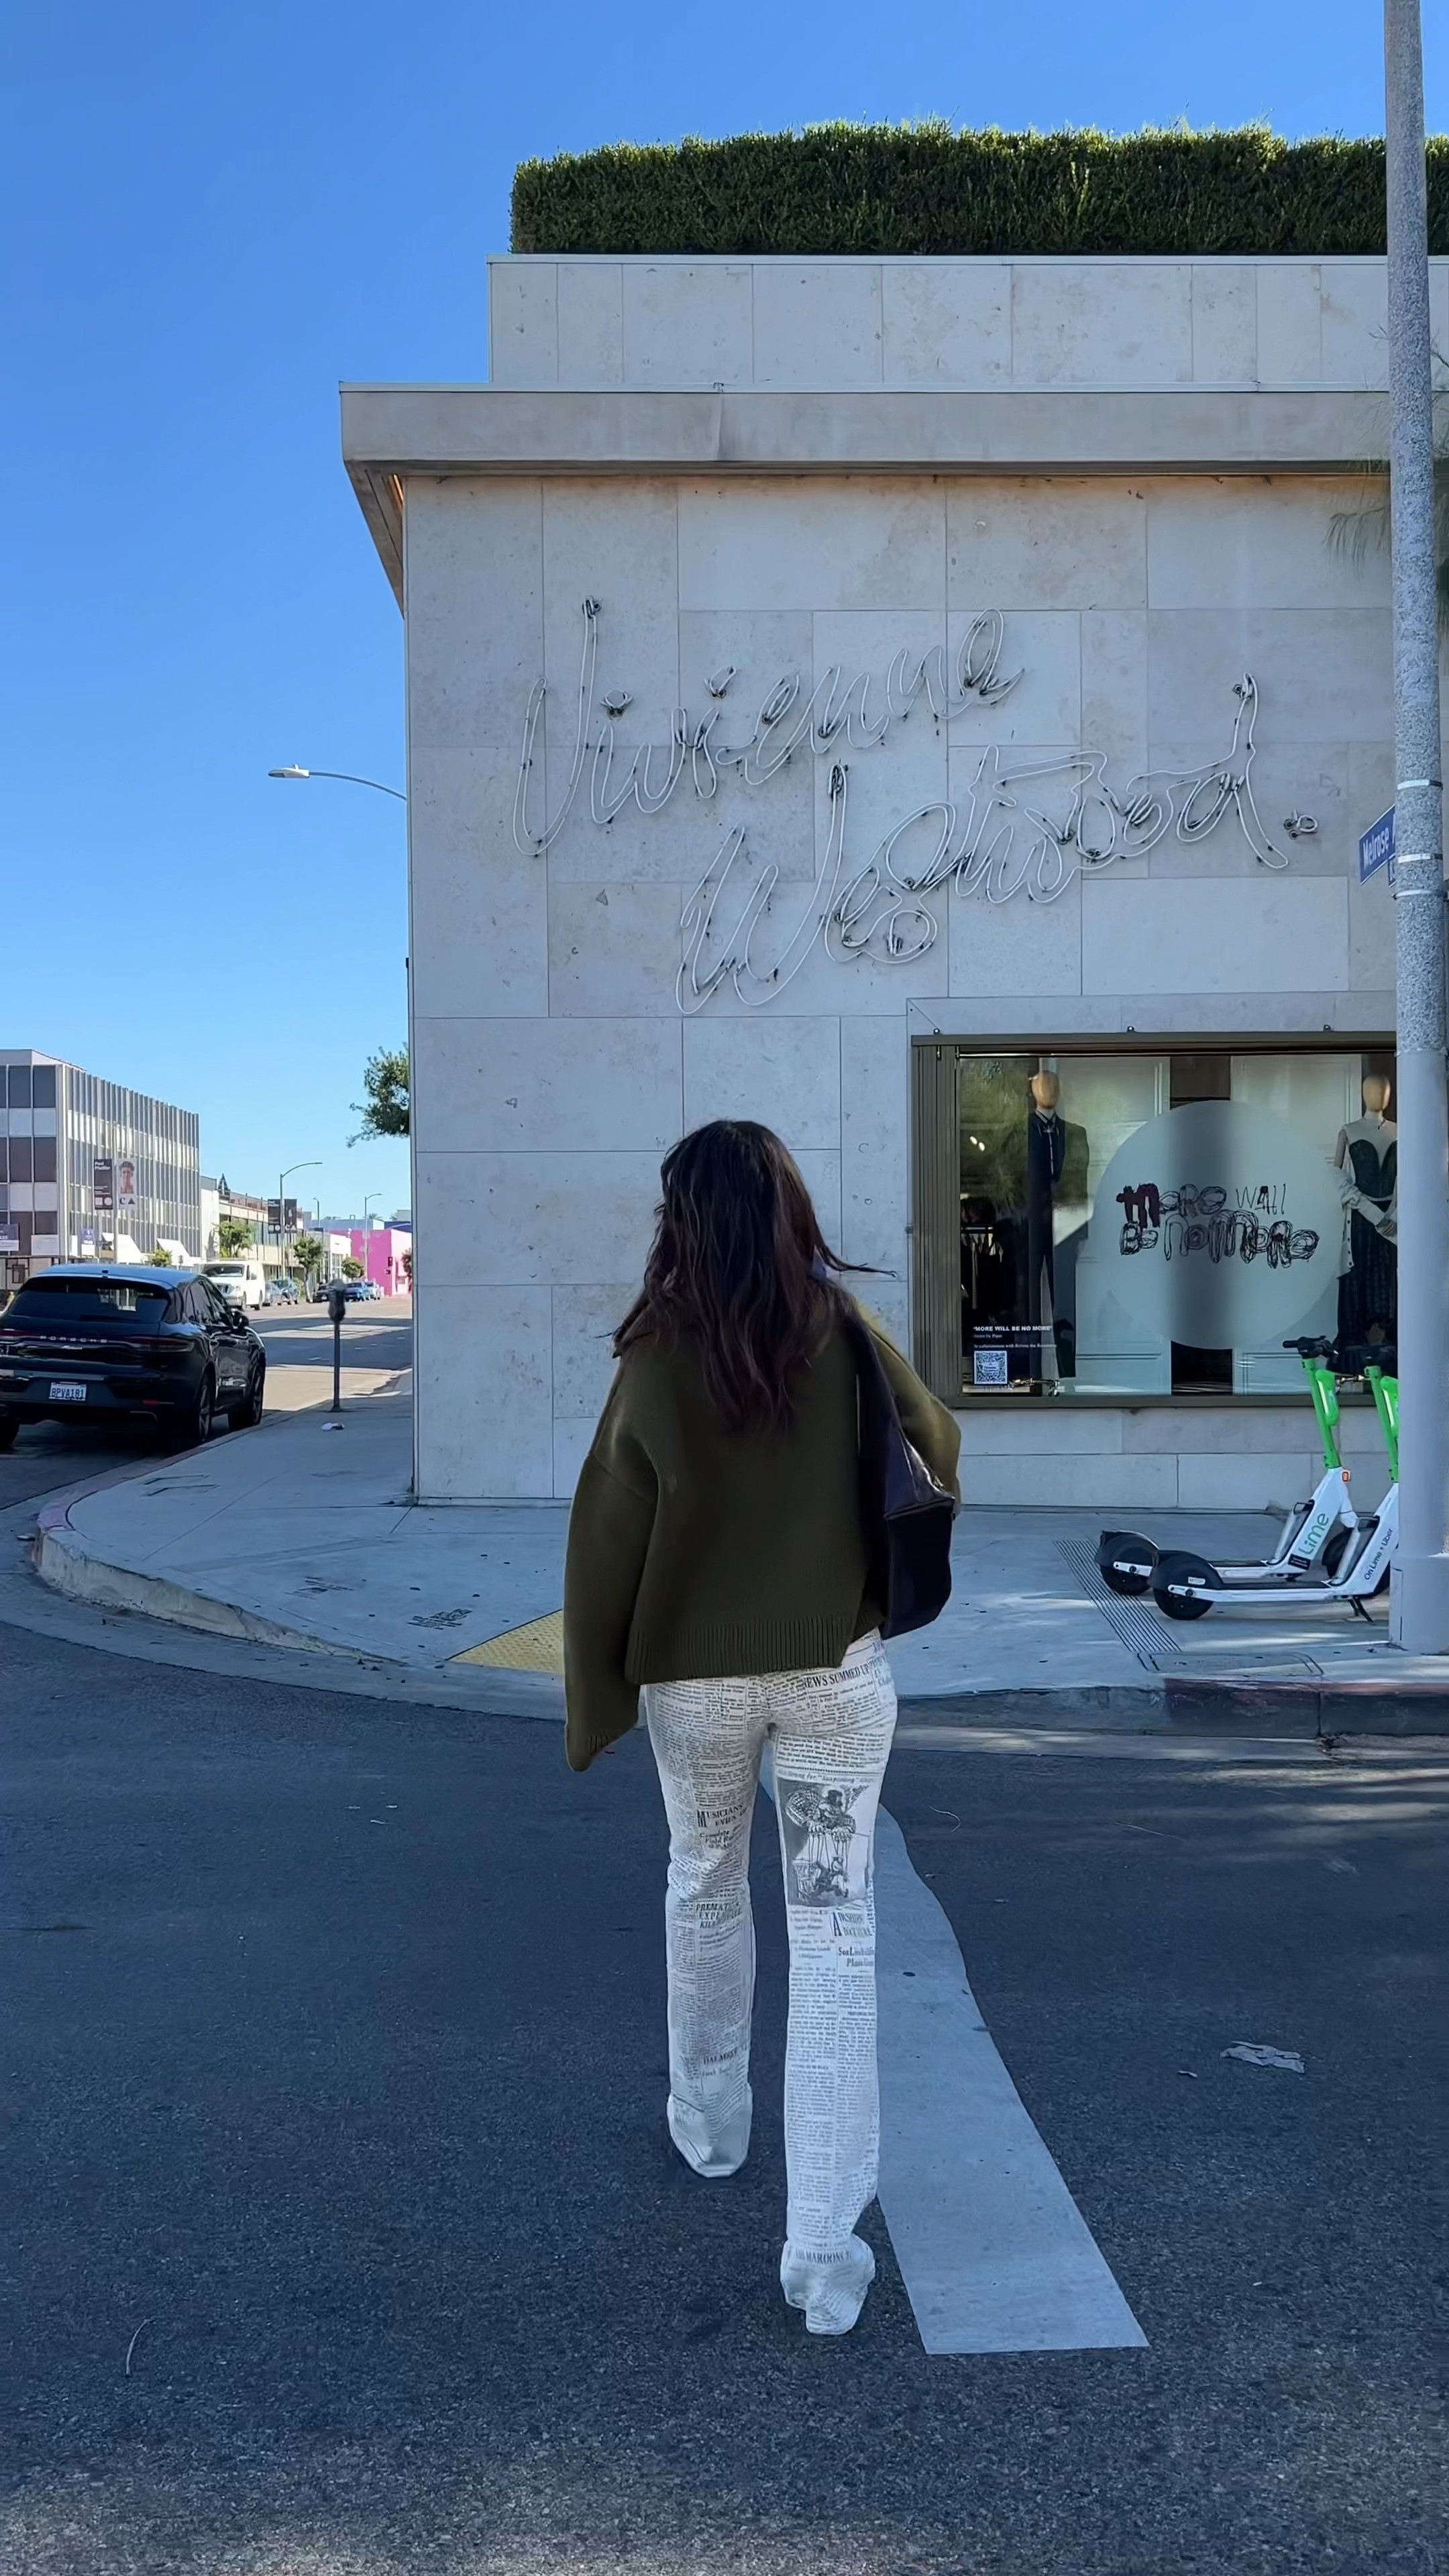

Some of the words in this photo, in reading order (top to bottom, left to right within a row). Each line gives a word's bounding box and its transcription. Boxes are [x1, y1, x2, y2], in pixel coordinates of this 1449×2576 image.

[514, 595, 1023, 856] Vivienne
[1363, 827, 1389, 871] Melrose
[1298, 1513, 1329, 1555] Lime
[1364, 1568, 1373, 1580] On
[829, 1666, 861, 1684] SUMMED
